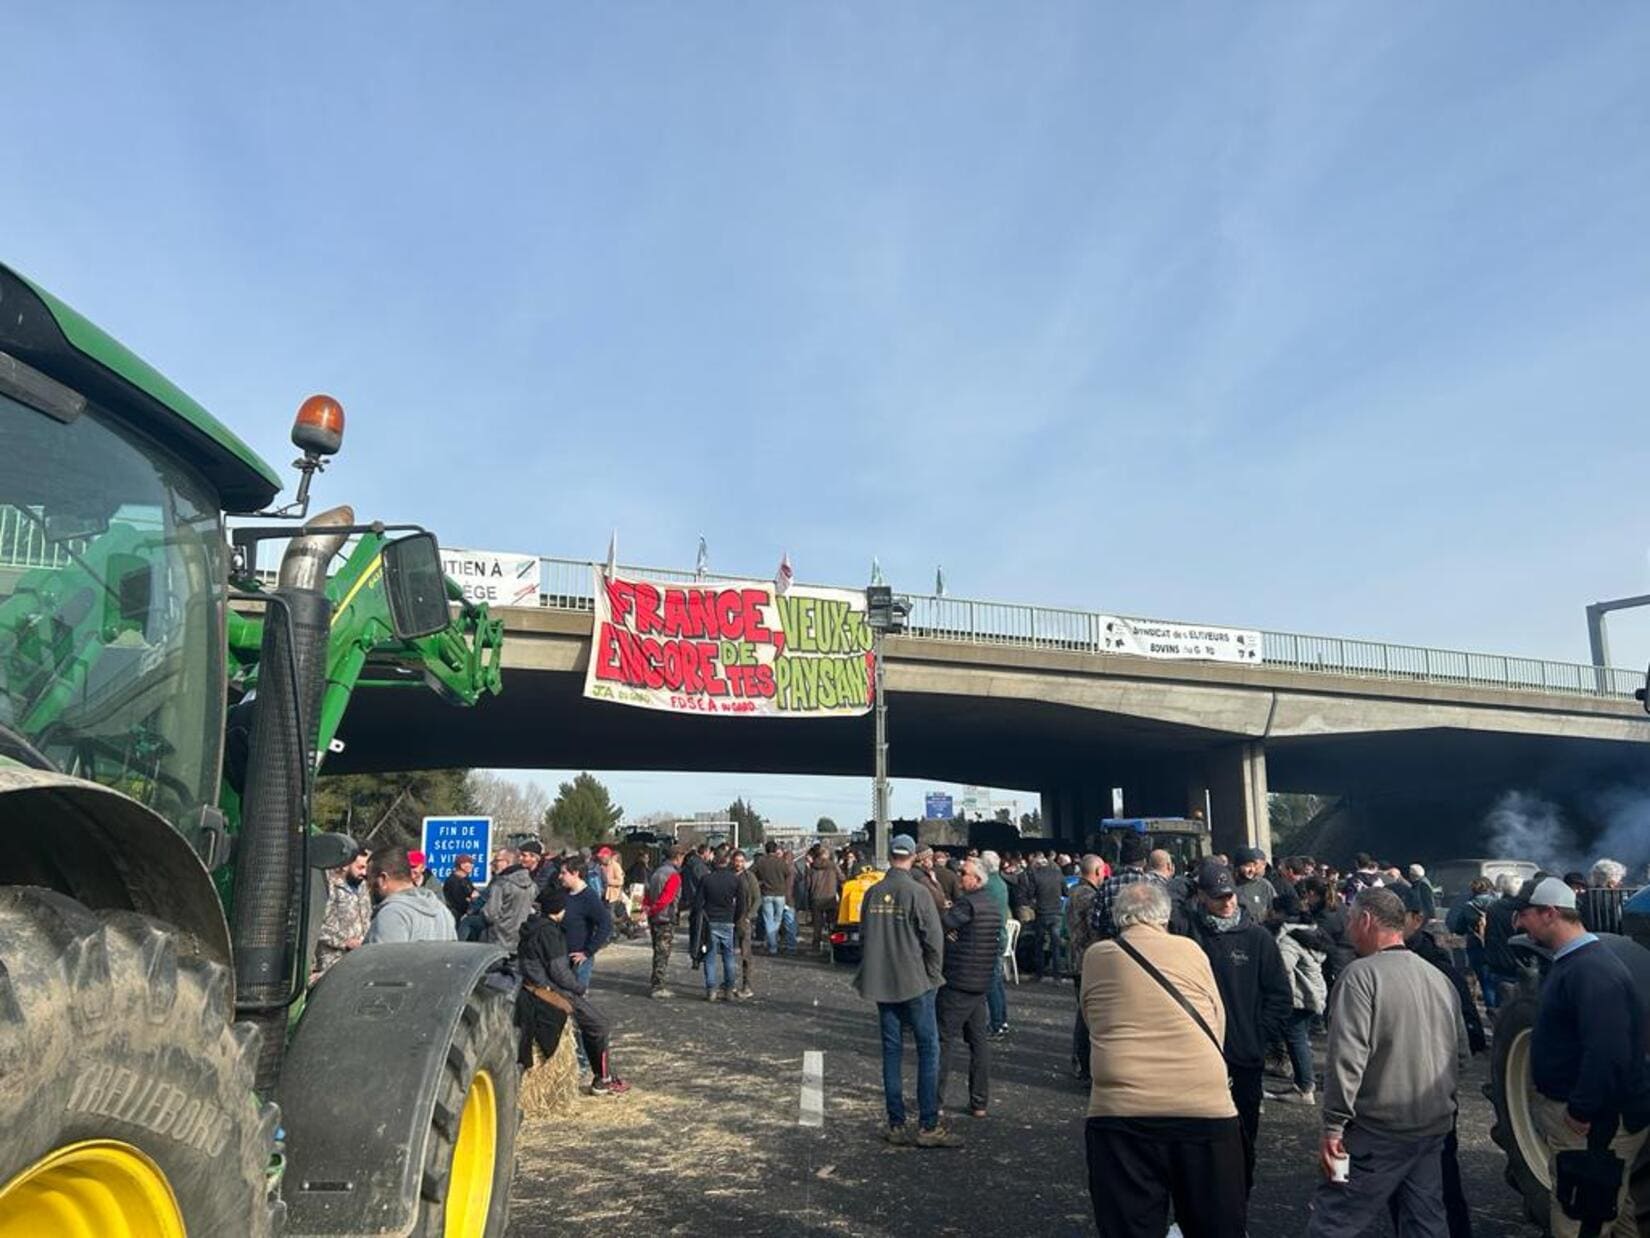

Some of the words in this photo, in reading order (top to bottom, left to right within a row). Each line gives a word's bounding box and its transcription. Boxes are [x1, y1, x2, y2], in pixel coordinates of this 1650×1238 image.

[442, 560, 485, 577] UTIEN
[463, 580, 498, 600] ÈGE
[604, 577, 786, 663] FRANCE,
[595, 621, 727, 698] ENCORE
[721, 640, 759, 667] DE
[725, 664, 777, 699] TES
[440, 826, 457, 836] FIN
[462, 826, 476, 836] DE
[434, 840, 480, 850] SECTION
[440, 853, 485, 864] VITSE
[431, 865, 480, 877] RÉGE
